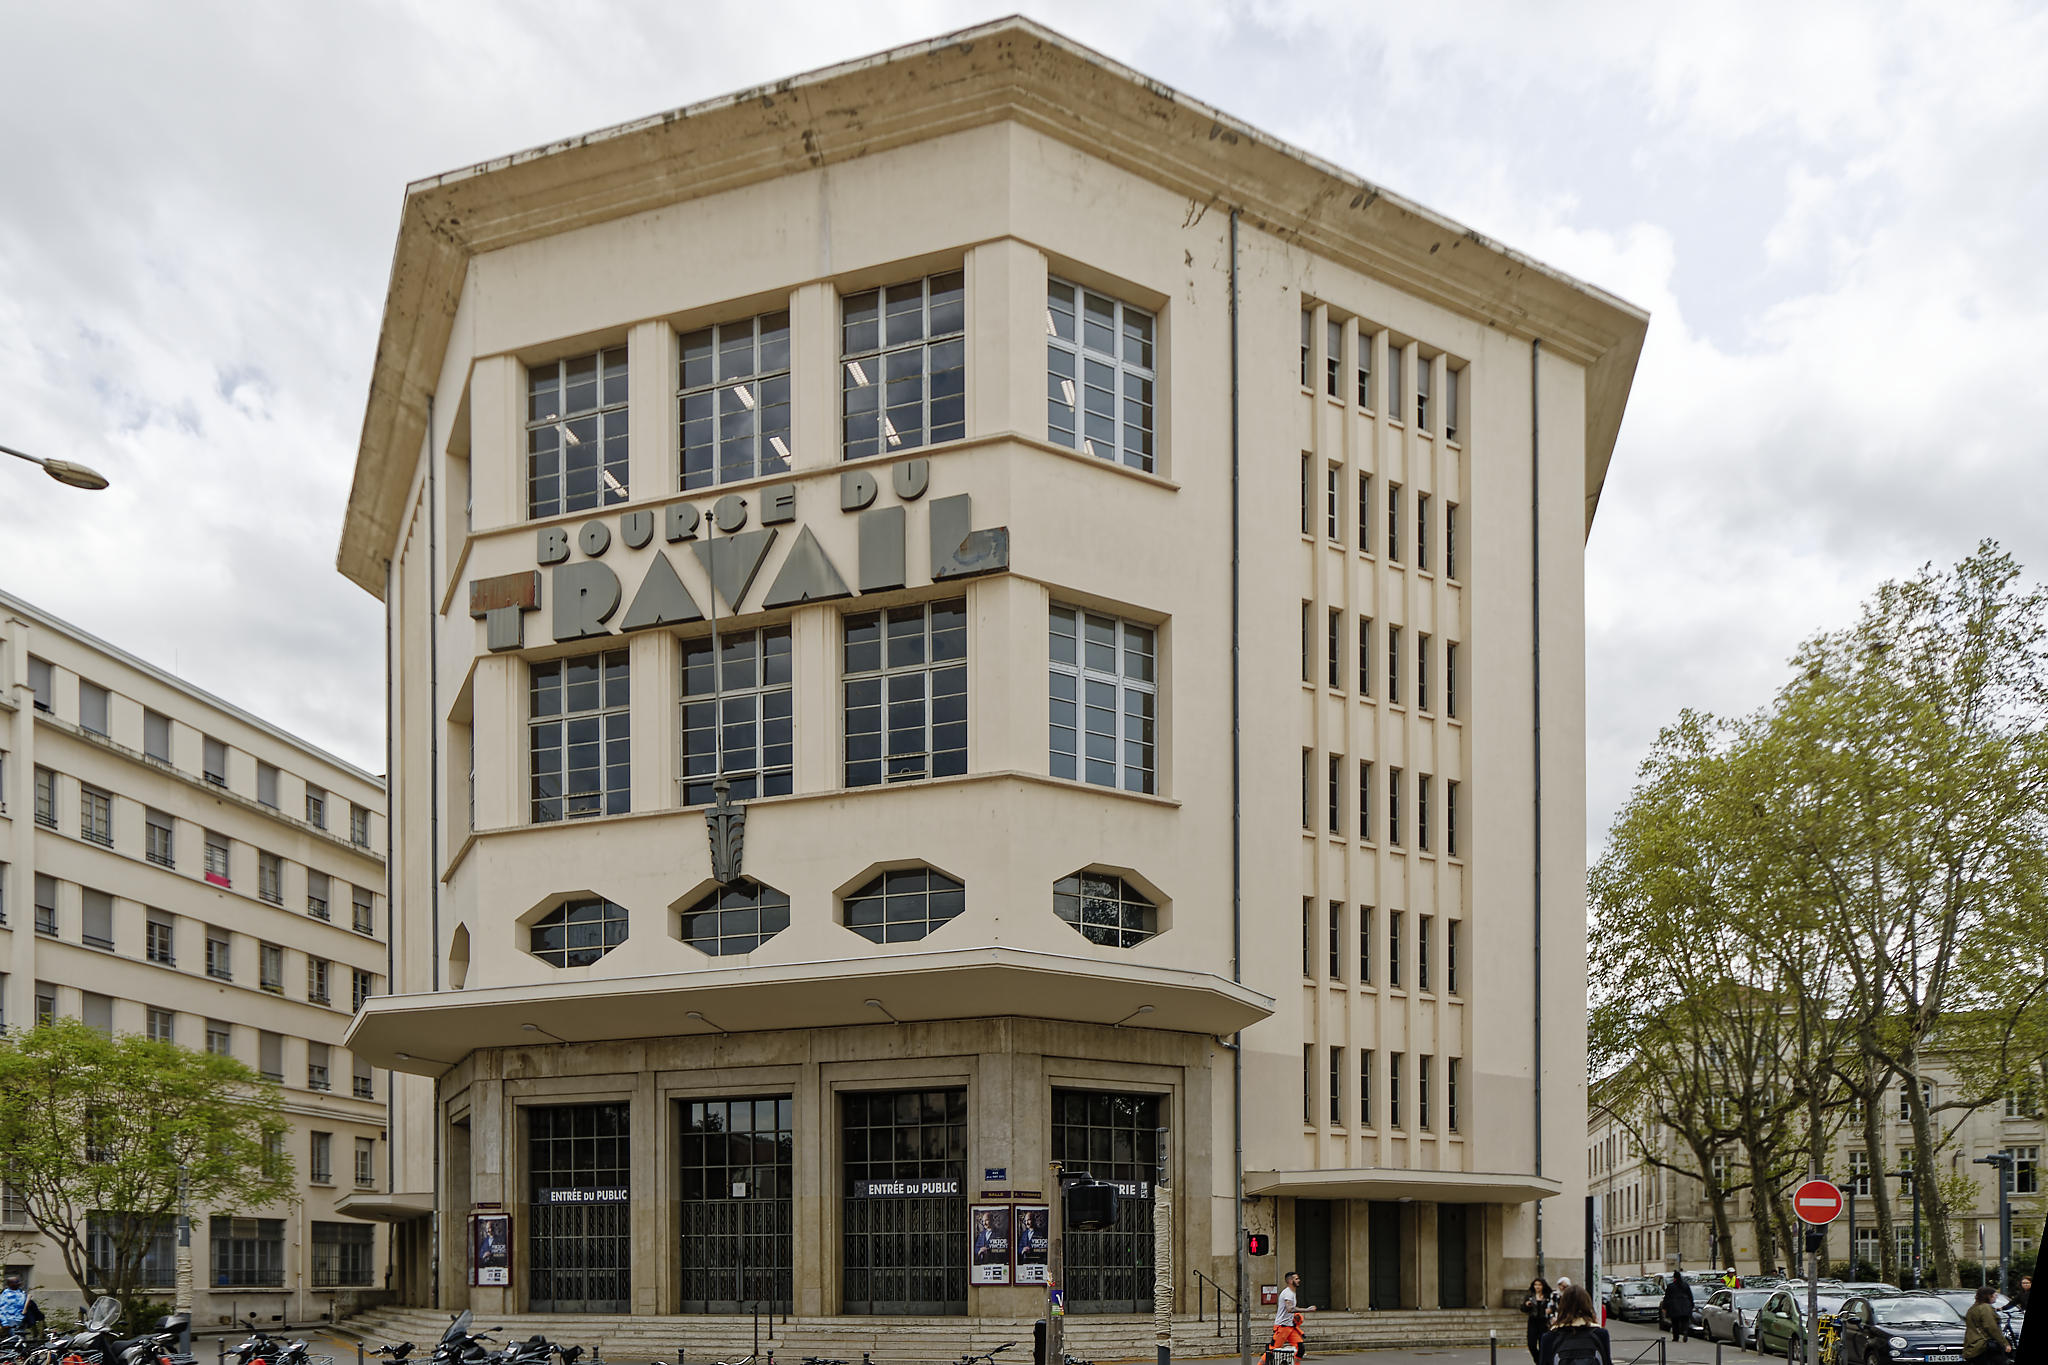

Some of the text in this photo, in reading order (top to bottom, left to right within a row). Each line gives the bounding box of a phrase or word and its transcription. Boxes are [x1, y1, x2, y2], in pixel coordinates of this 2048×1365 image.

[537, 458, 930, 566] BOURSE DU
[469, 493, 1010, 653] TRAVAIL
[550, 1187, 628, 1201] ENTRÉE DU PUBLIC
[868, 1180, 957, 1195] ENTRÉE DU PUBLIC
